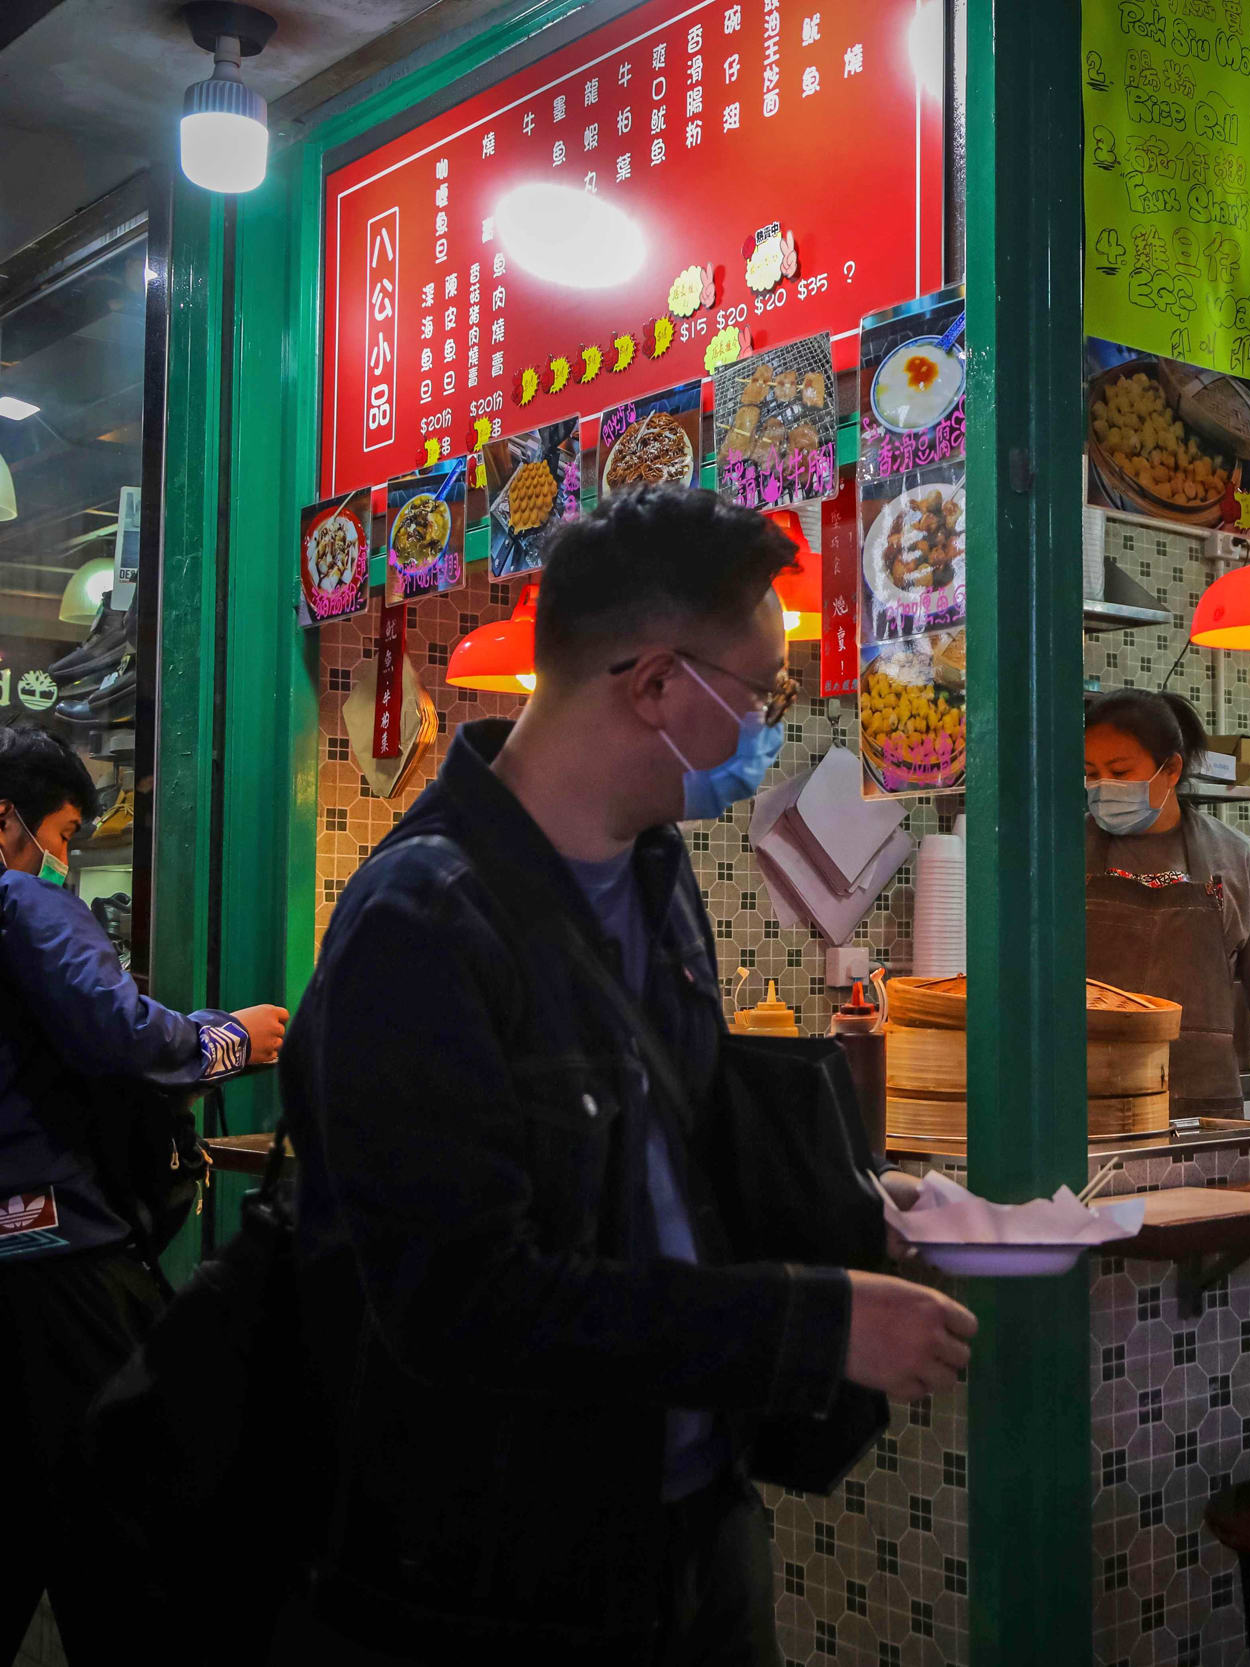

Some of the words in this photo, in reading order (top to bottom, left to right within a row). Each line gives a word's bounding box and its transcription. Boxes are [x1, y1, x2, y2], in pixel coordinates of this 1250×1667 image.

[616, 61, 632, 183] 牛柏葉
[650, 42, 667, 167] 爽口魷魚
[685, 23, 703, 149] 香滑腸粉
[723, 4, 741, 133] 碗仔翅
[584, 77, 599, 193] 龍蝦丸
[368, 227, 394, 431] 八公小品
[420, 282, 435, 405] 深海魚旦
[442, 272, 458, 396] 陳皮魚旦
[491, 253, 506, 378] 魚肉燒賣
[680, 318, 707, 343] $15
[716, 303, 748, 330] $20
[754, 288, 787, 316] $20
[797, 273, 829, 300] $35
[843, 260, 857, 284] ?
